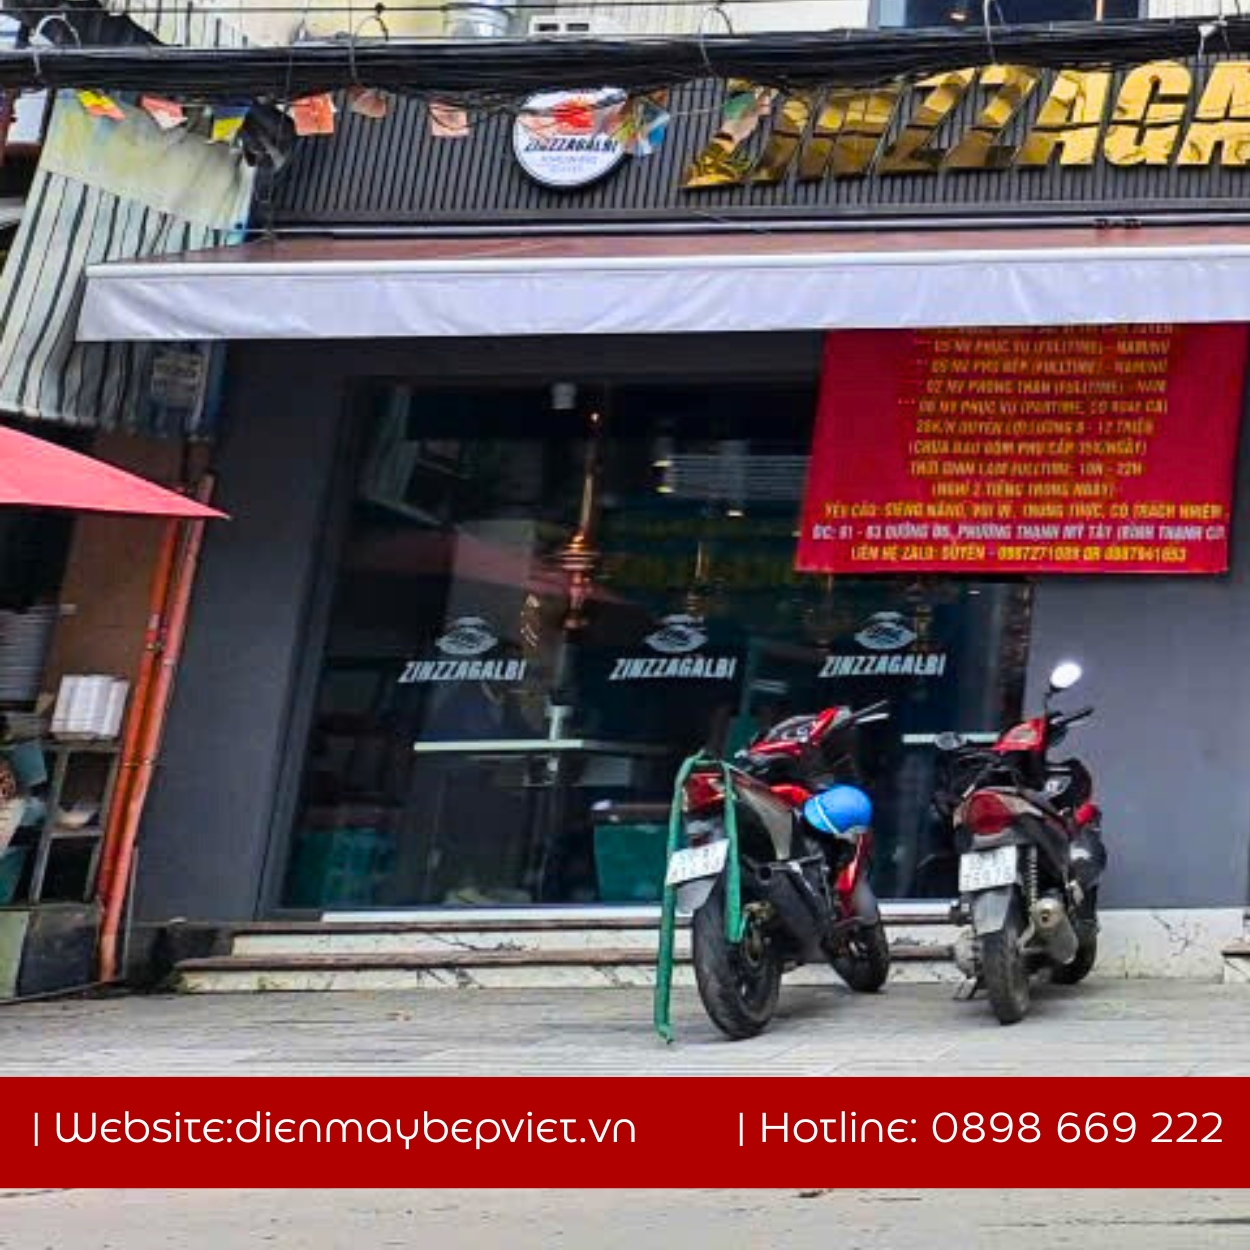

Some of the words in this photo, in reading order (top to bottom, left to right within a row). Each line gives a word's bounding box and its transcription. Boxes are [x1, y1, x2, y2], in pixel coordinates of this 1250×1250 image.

[398, 660, 525, 683] ZINZZAGALBI
[608, 657, 738, 681] ZINZZAGALBI
[818, 653, 946, 678] ZINZZAGALBI
